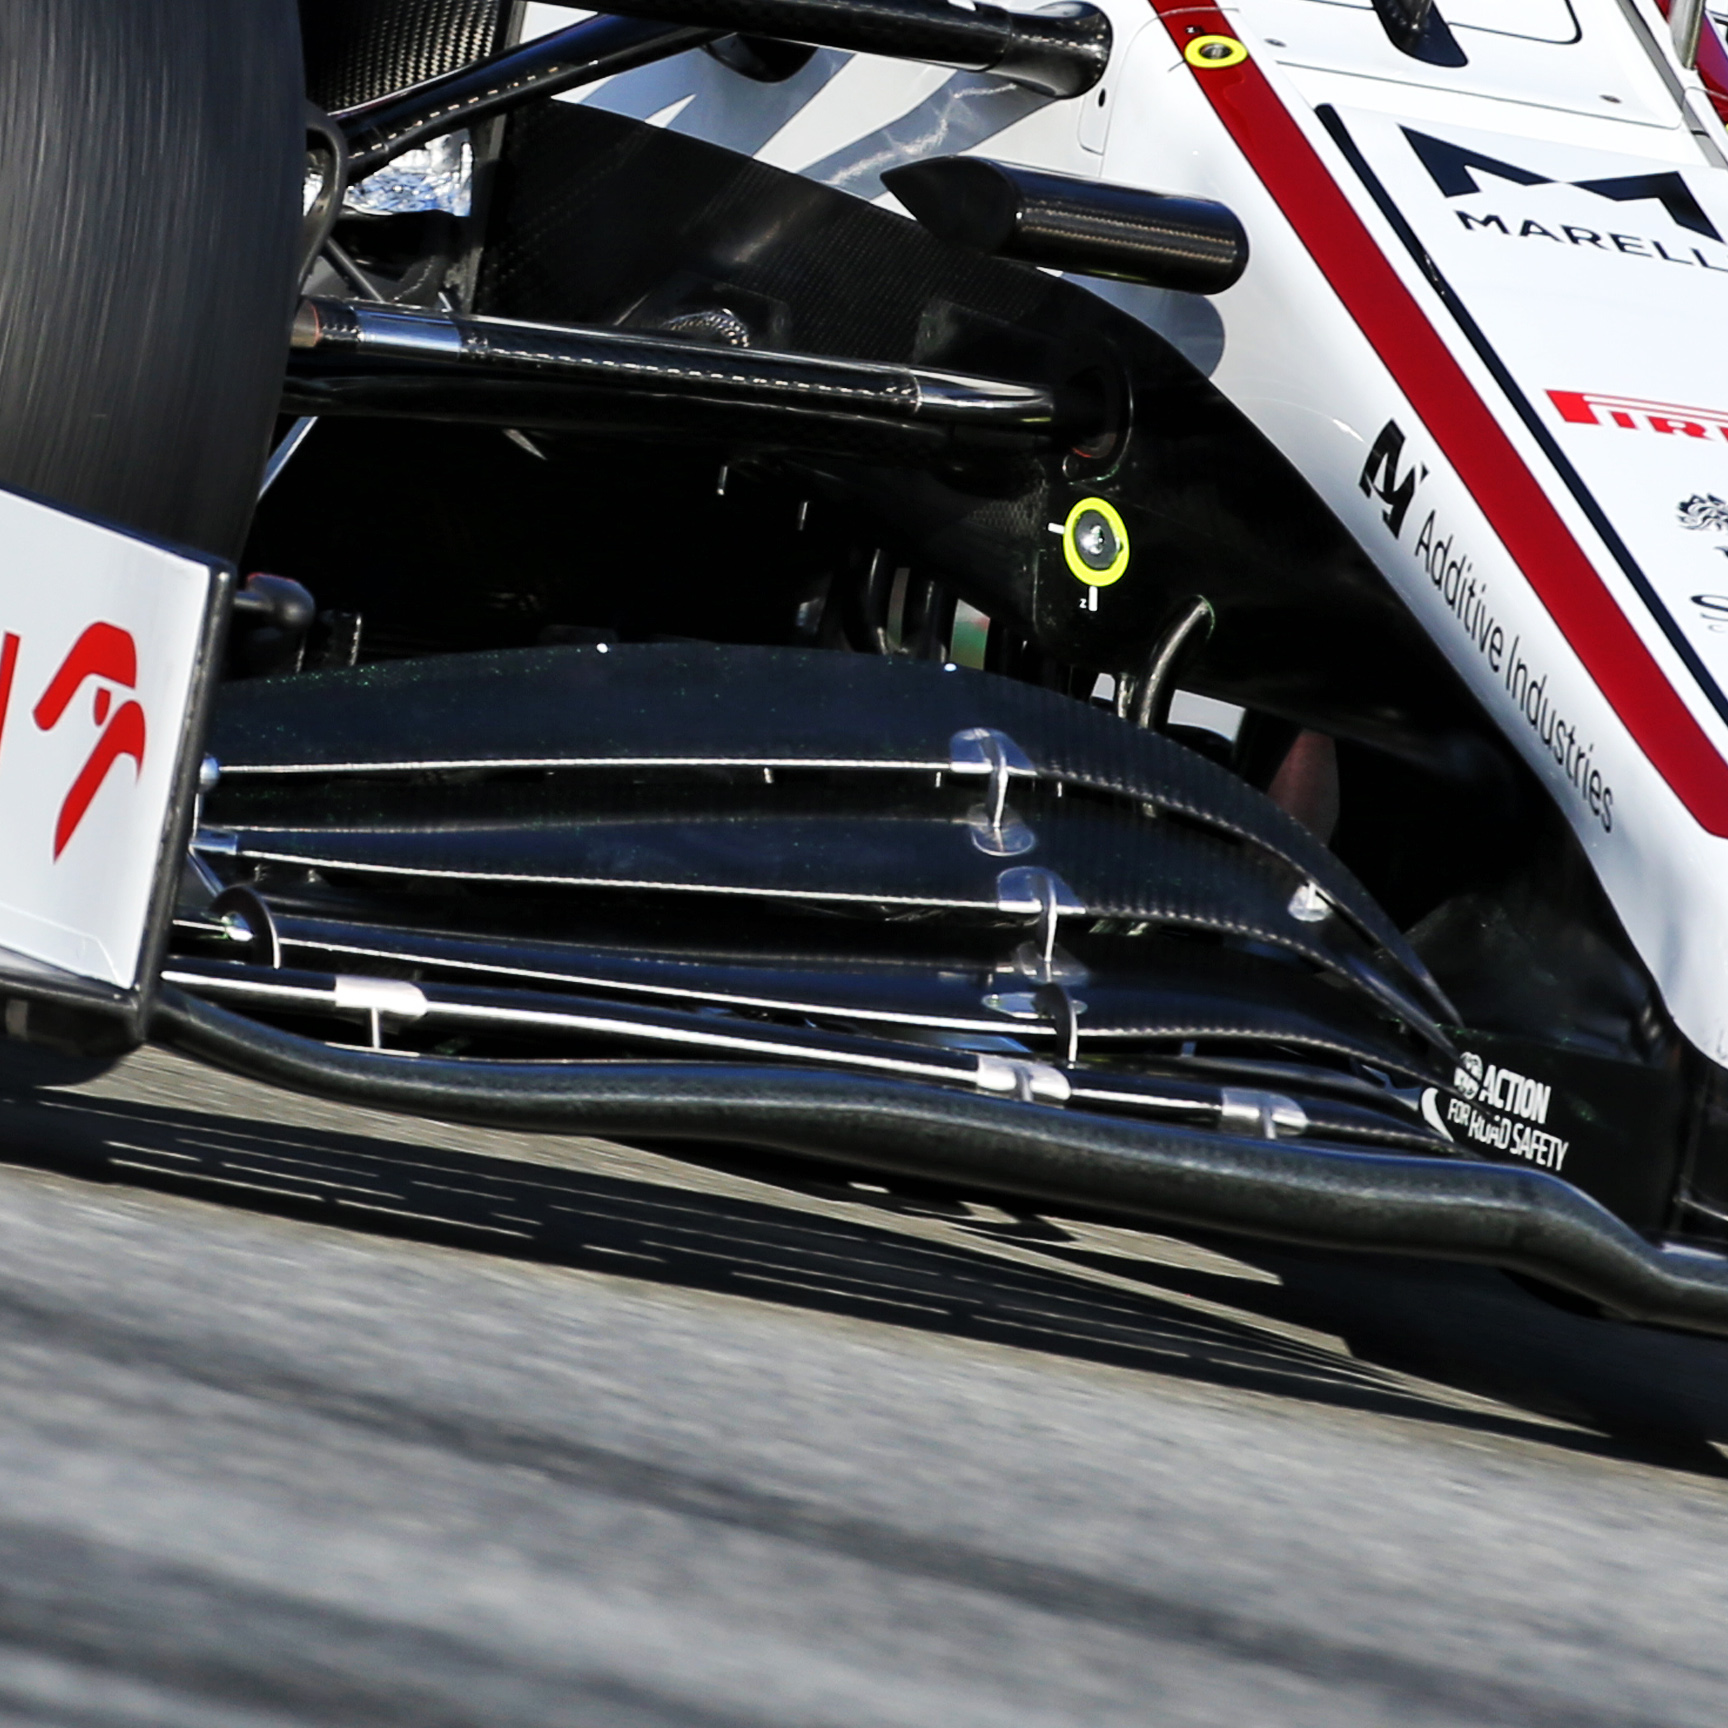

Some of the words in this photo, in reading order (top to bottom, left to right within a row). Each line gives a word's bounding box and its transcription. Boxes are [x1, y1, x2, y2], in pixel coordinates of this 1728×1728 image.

[1414, 510, 1505, 674] Additive
[1504, 635, 1614, 834] Industries
[1478, 1064, 1552, 1124] ACTION
[1447, 1098, 1472, 1127] FOR
[1509, 1122, 1570, 1171] SAFETY
